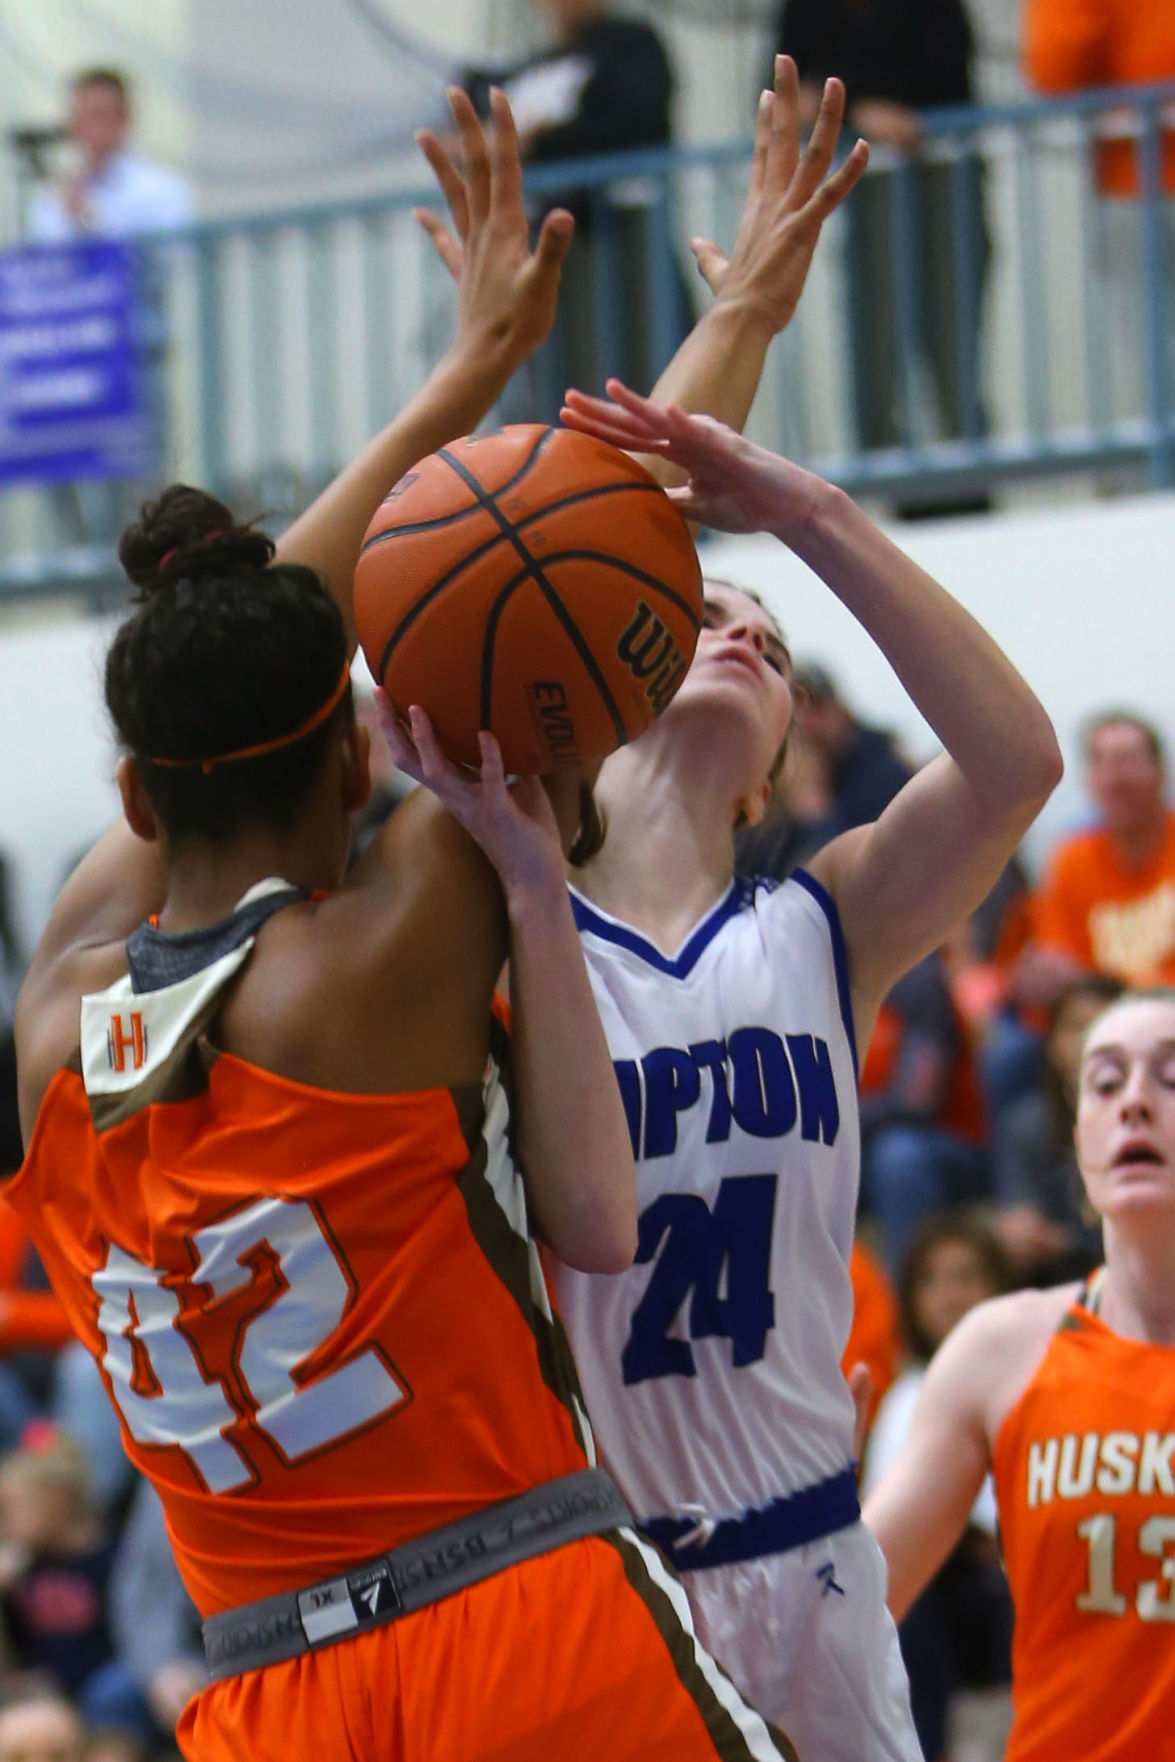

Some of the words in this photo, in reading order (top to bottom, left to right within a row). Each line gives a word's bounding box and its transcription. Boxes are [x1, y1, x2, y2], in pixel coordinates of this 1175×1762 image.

[107, 1012, 148, 1072] H
[622, 1174, 778, 1386] 24
[88, 1191, 414, 1497] 42
[1027, 1431, 1175, 1510] HUSK
[1075, 1512, 1175, 1622] 13
